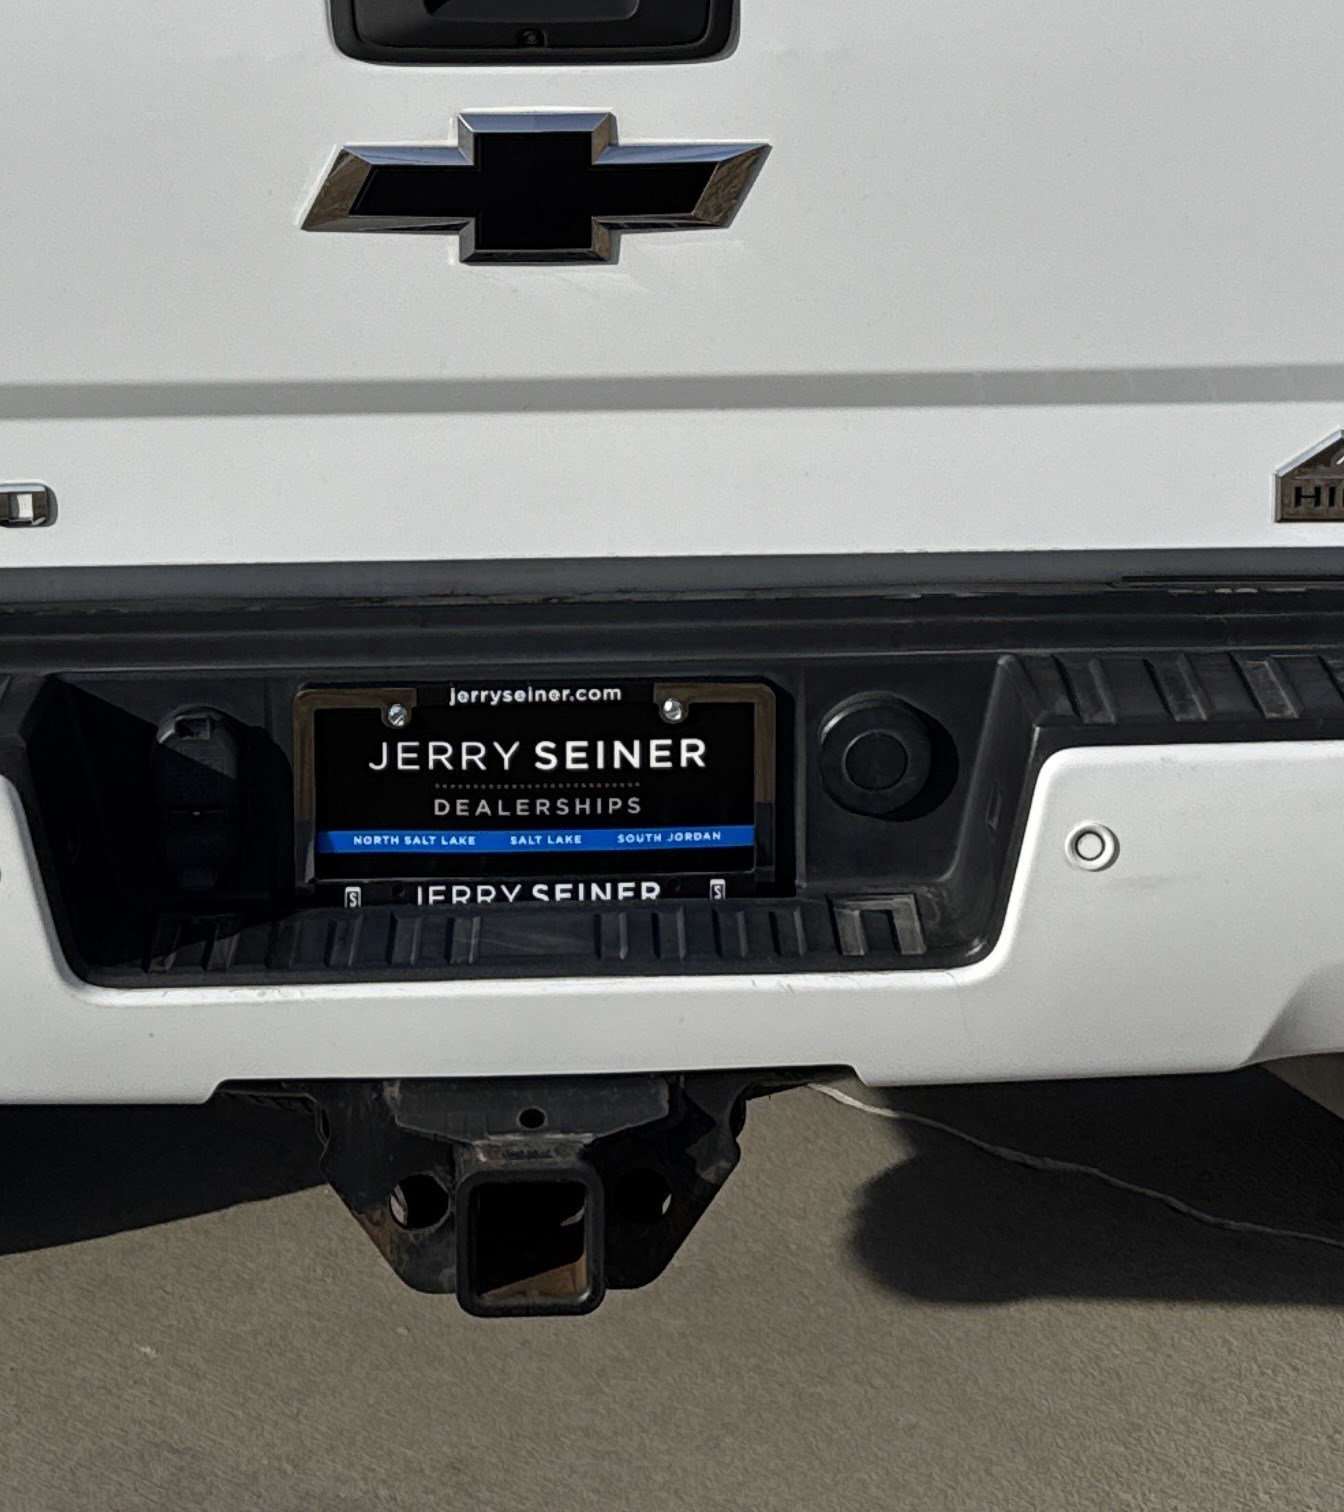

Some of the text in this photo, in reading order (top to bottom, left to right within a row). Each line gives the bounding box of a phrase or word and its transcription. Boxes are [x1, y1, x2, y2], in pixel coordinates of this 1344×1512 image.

[449, 683, 622, 706] jerryseiner.com
[368, 738, 707, 771] JERRY SEINER
[433, 796, 642, 817] DEALERSHIPS
[353, 834, 476, 846] NORTH SALT LAKE
[509, 834, 582, 846] SALT LAKE
[617, 830, 722, 844] SOUTH JORDAN
